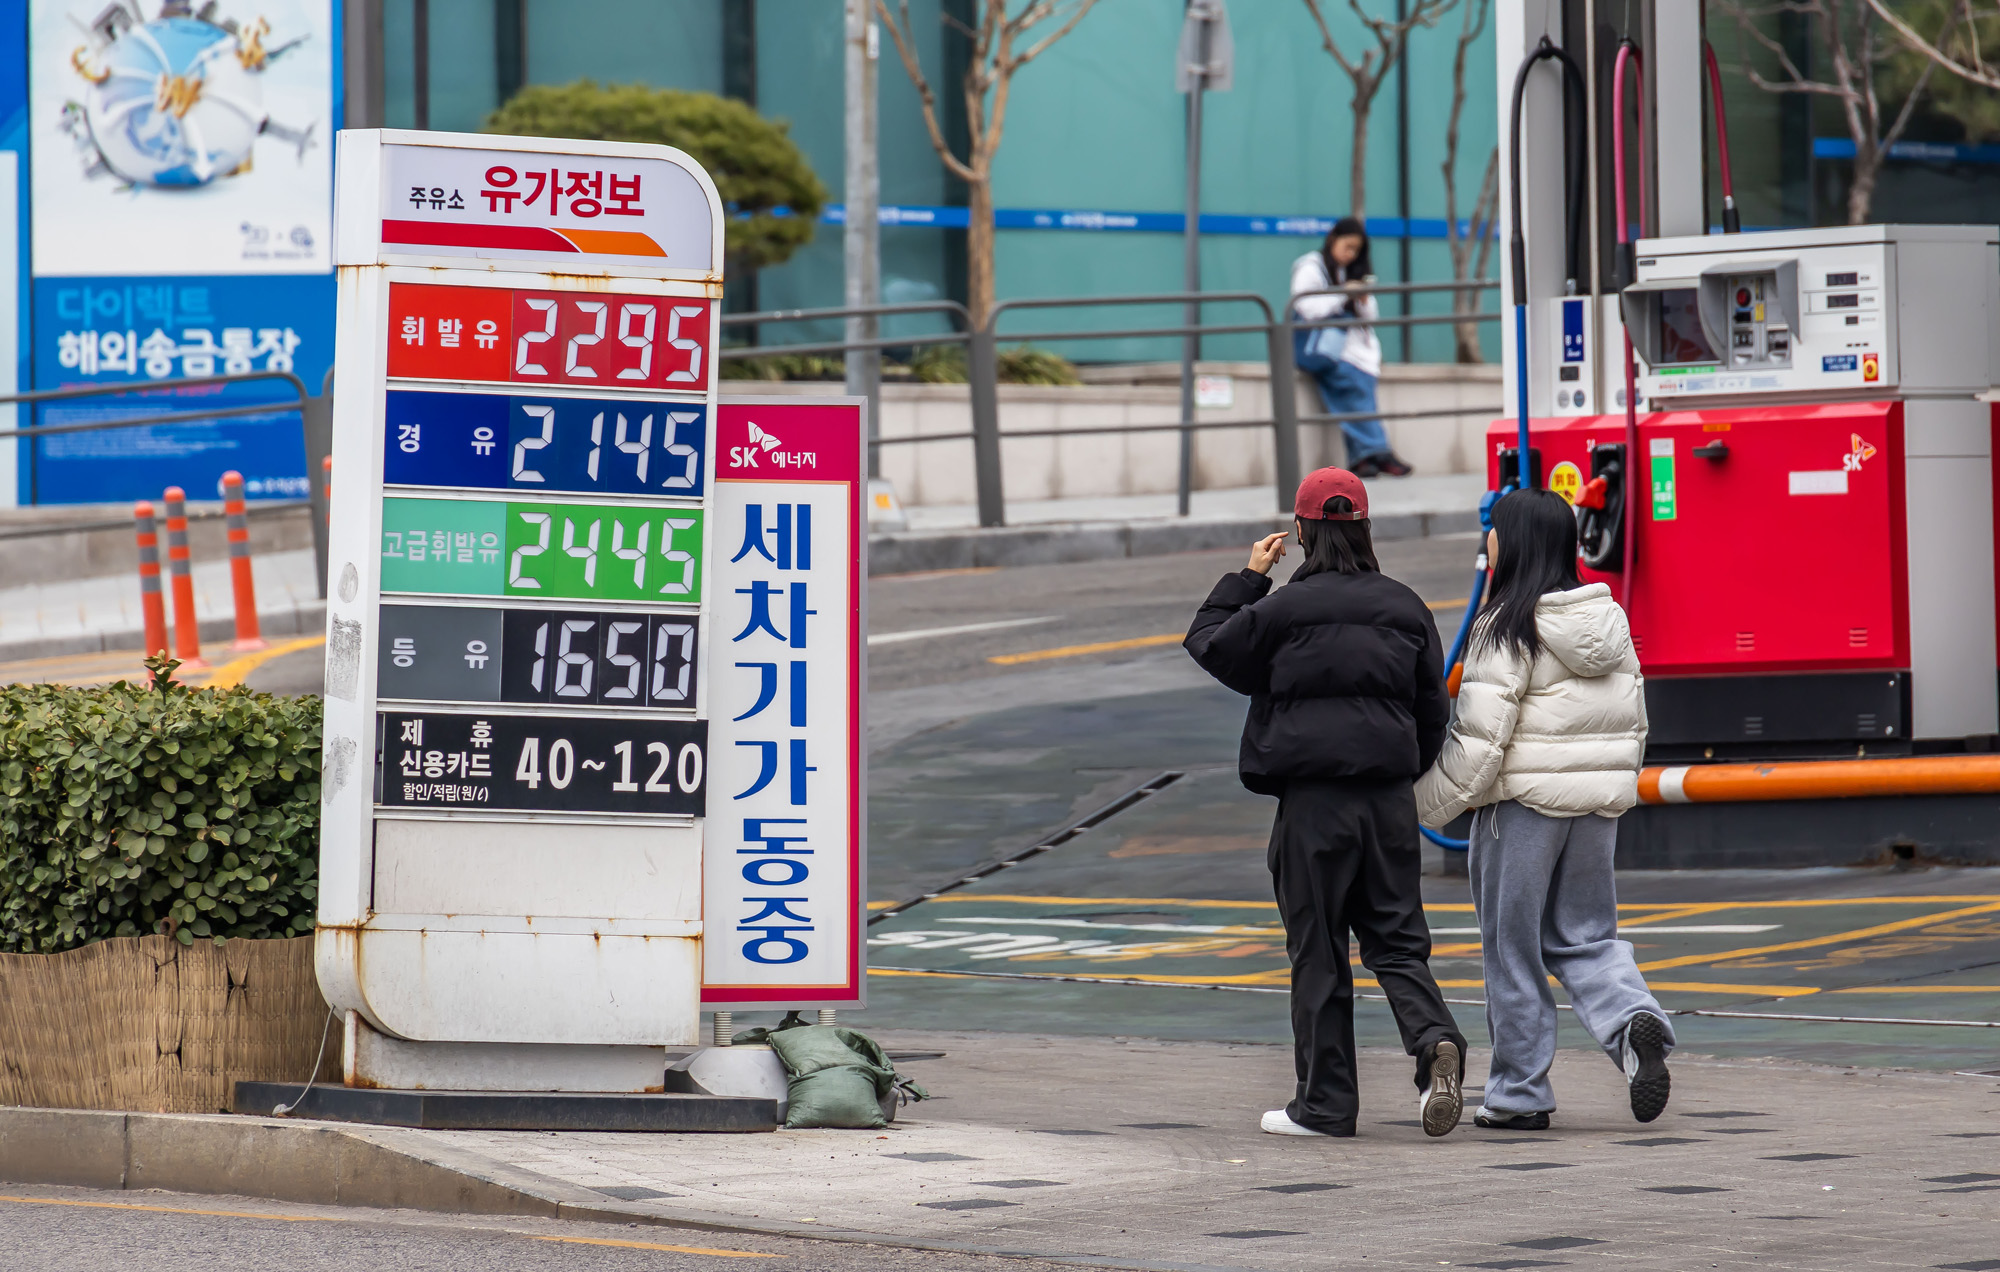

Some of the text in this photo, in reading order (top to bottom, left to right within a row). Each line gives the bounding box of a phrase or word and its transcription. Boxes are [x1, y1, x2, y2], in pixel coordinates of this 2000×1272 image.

[409, 165, 645, 218] 주유소 유가정보
[57, 284, 215, 330] 다이렉트
[57, 327, 301, 379] 해외송금통장
[515, 299, 704, 382] 2295
[511, 404, 701, 489] 2145
[729, 446, 816, 469] SK 에너지
[1843, 453, 1862, 471] SK
[382, 512, 697, 594] 고급휘발유 2445
[530, 619, 695, 700] 1650
[400, 750, 492, 778] 신용카드
